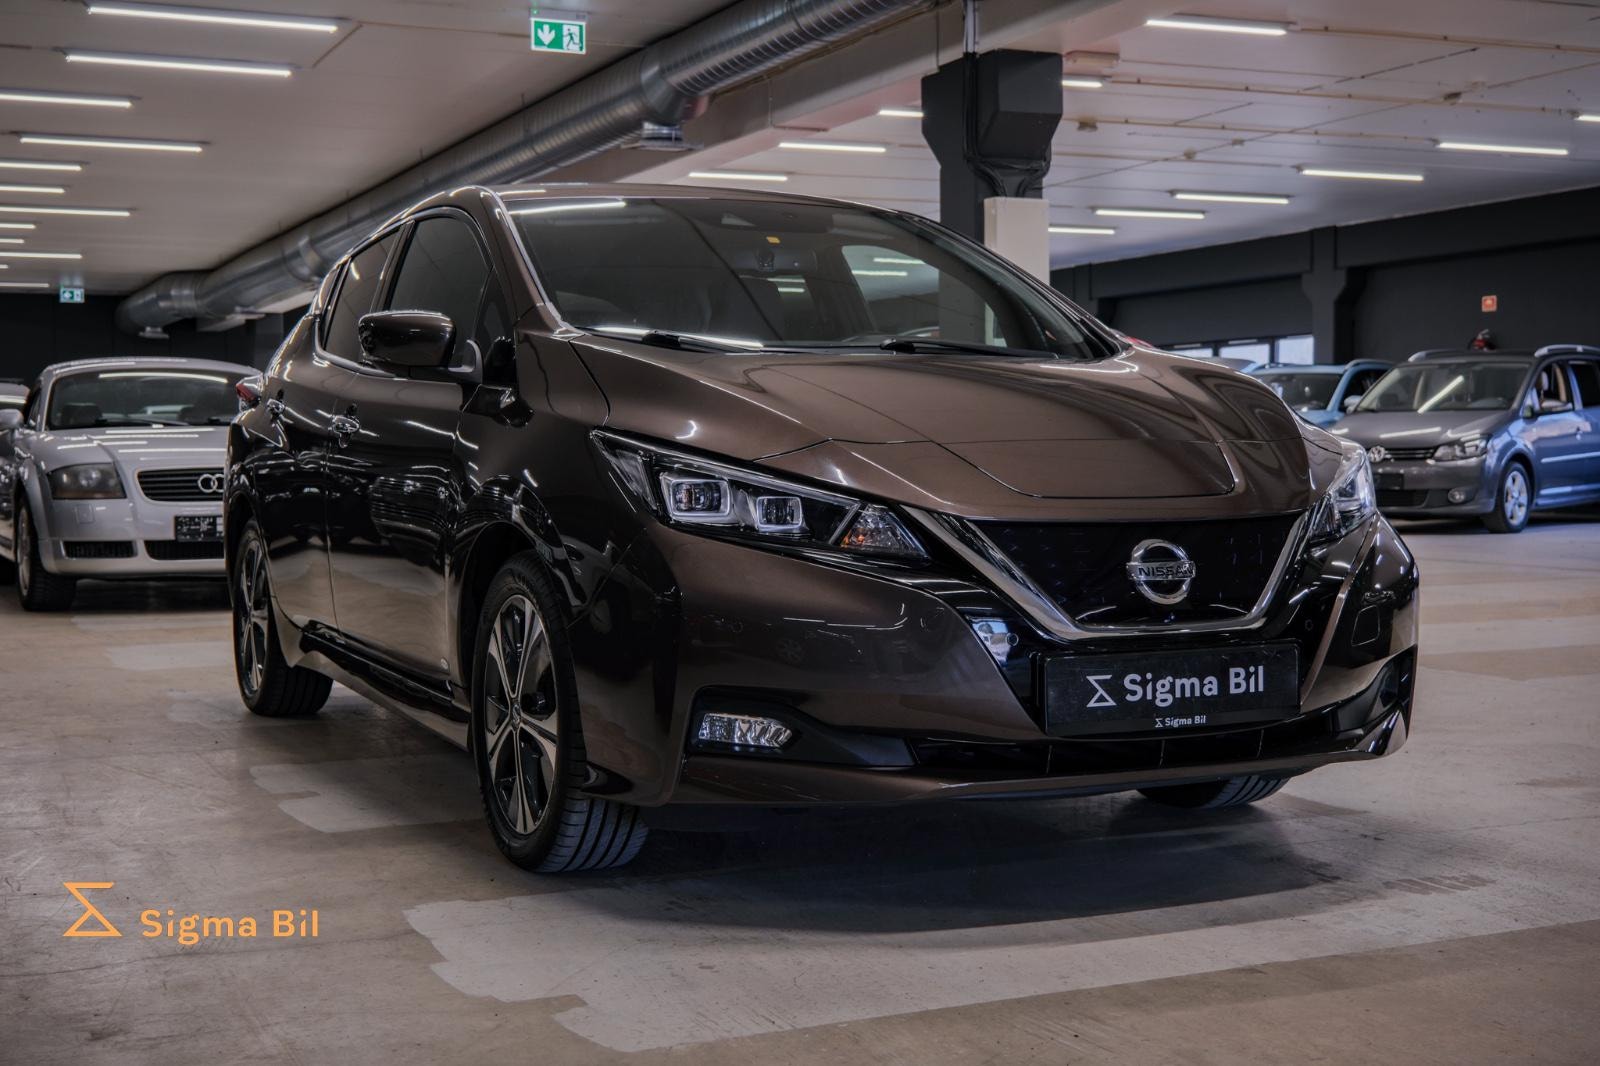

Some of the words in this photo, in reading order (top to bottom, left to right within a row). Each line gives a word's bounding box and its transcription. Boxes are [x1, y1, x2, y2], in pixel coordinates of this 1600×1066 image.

[1138, 565, 1193, 577] NISSAN
[1123, 672, 1218, 707] Sigma
[1229, 665, 1264, 695] Bil
[1164, 717, 1192, 728] Sigma
[1194, 715, 1206, 724] Bil
